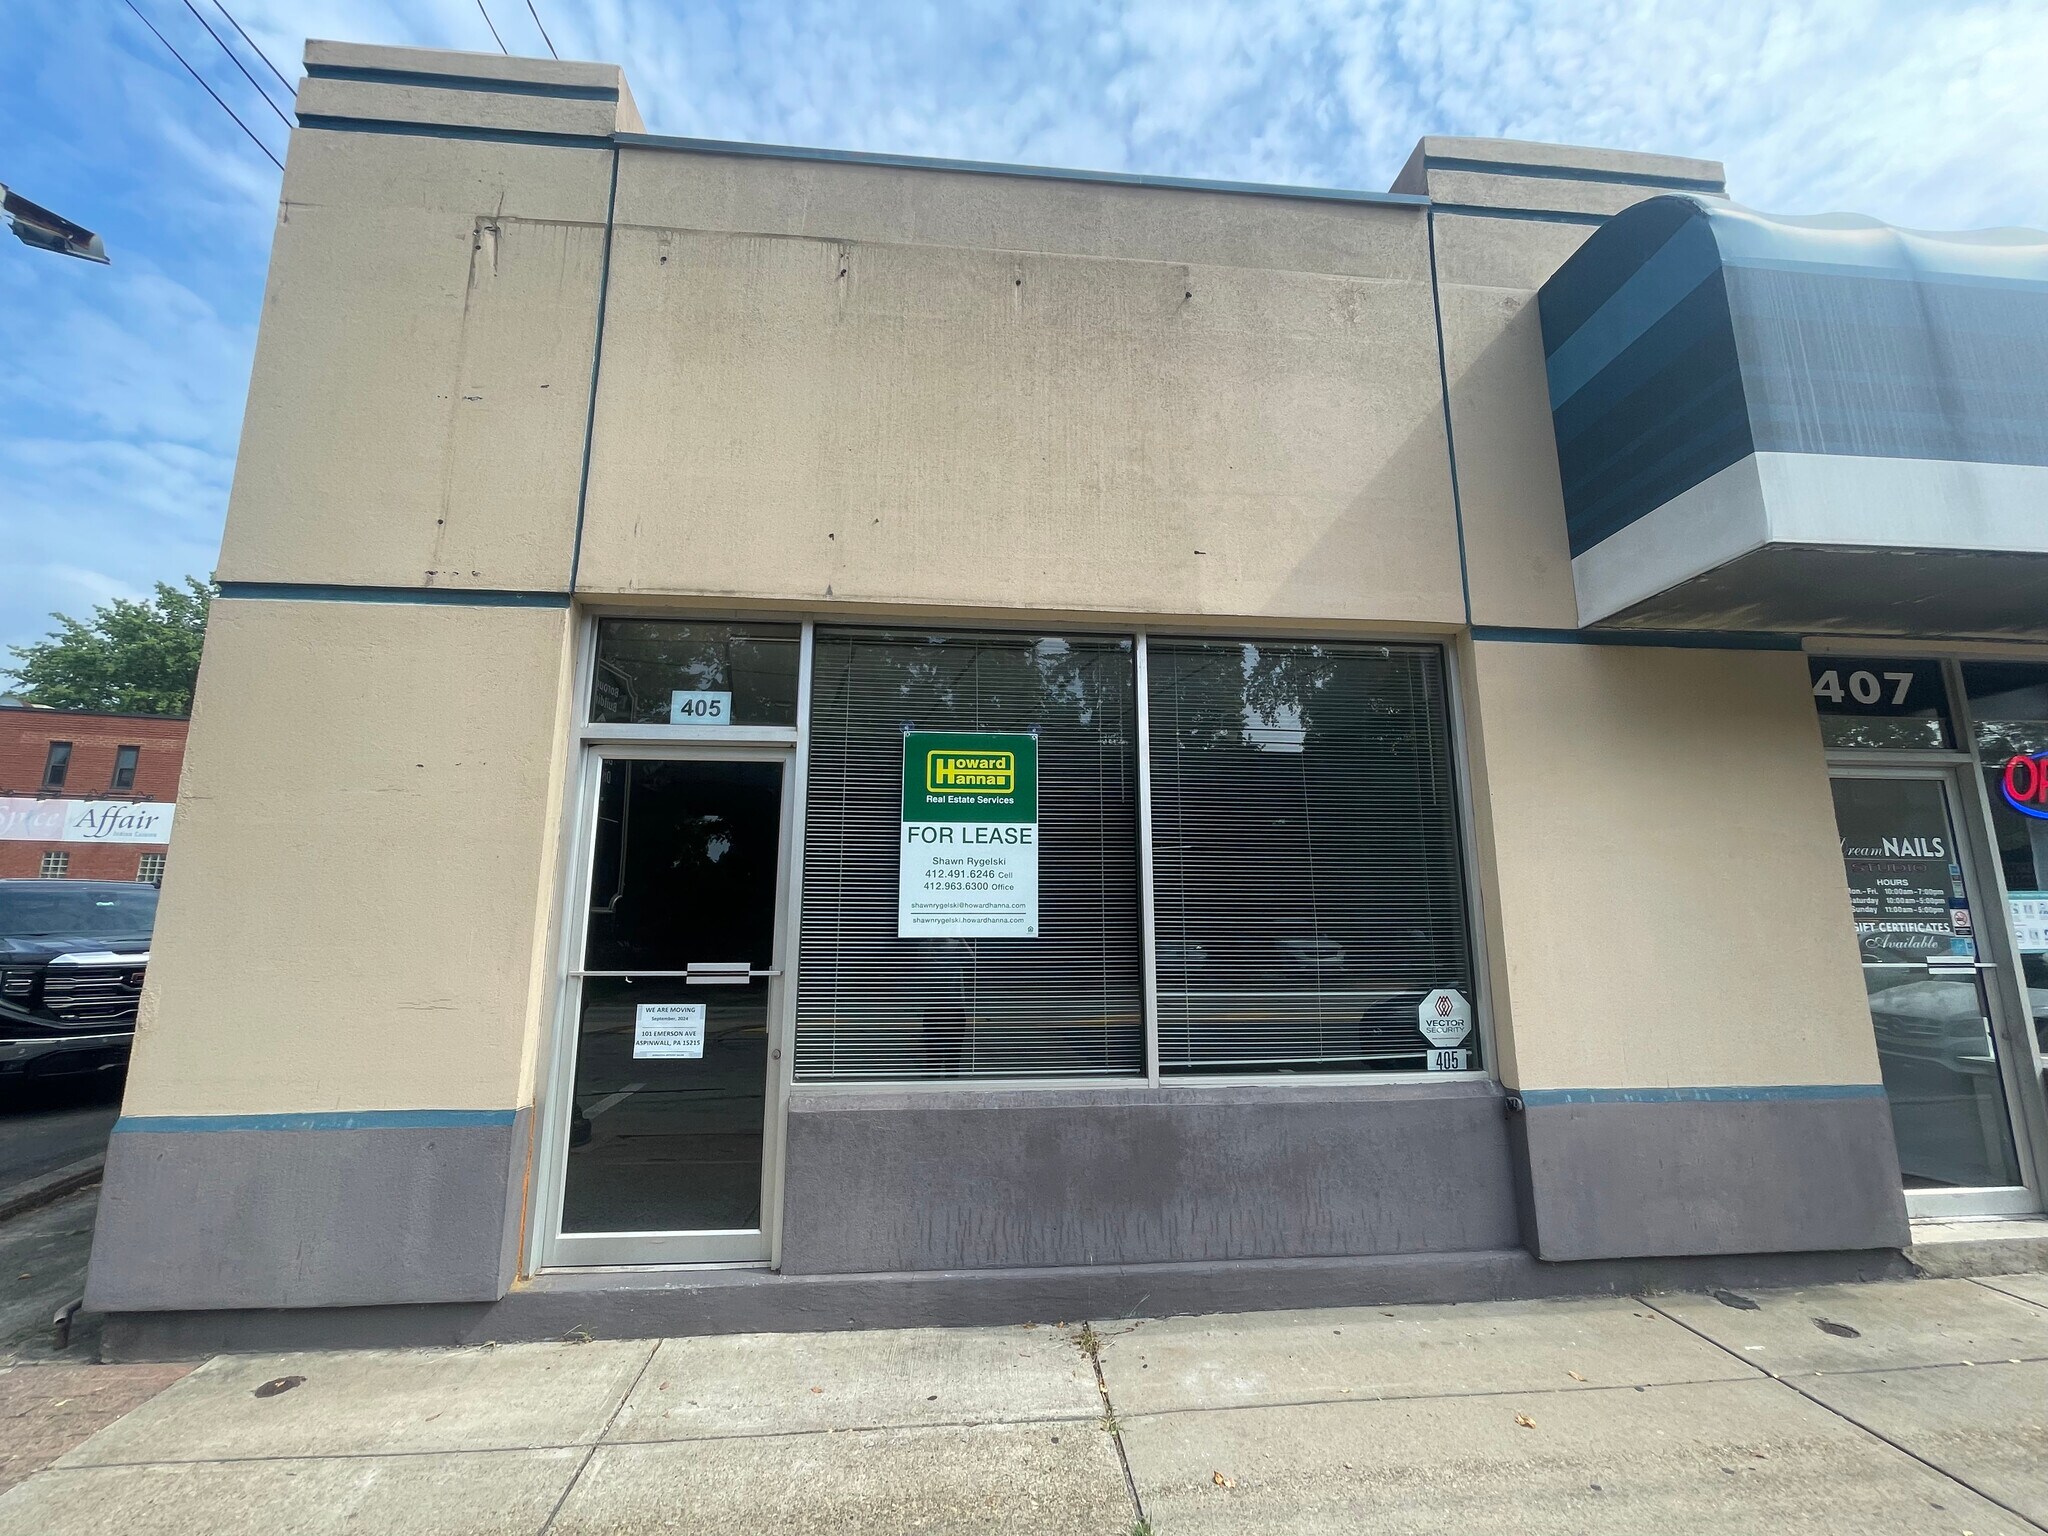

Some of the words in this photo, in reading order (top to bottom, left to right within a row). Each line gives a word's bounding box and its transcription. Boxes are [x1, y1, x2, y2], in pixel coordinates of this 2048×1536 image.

[1813, 670, 1914, 705] 407
[680, 698, 721, 717] 405
[926, 795, 946, 803] Real
[948, 796, 975, 804] Estate
[979, 796, 1015, 804] Services
[73, 805, 160, 839] Affair
[908, 826, 954, 844] FOR
[962, 827, 1033, 845] LEASE
[1882, 837, 1945, 858] NAILS
[932, 857, 964, 865] Shawn
[967, 857, 1007, 867] Rygelski
[925, 869, 995, 879] 412.491.6246
[998, 871, 1013, 879] Cell
[924, 882, 988, 891] 412.963.6300
[991, 883, 1015, 891] Office
[911, 902, 1026, 910] shawnrygelski@howardhanna.com
[912, 917, 1025, 925] shawnrygelski.howardhanna.com
[1878, 923, 1950, 932] CERTIFICATES
[1865, 934, 1938, 949] Available
[1426, 1019, 1464, 1027] VECTOR
[1436, 1051, 1458, 1070] 405
